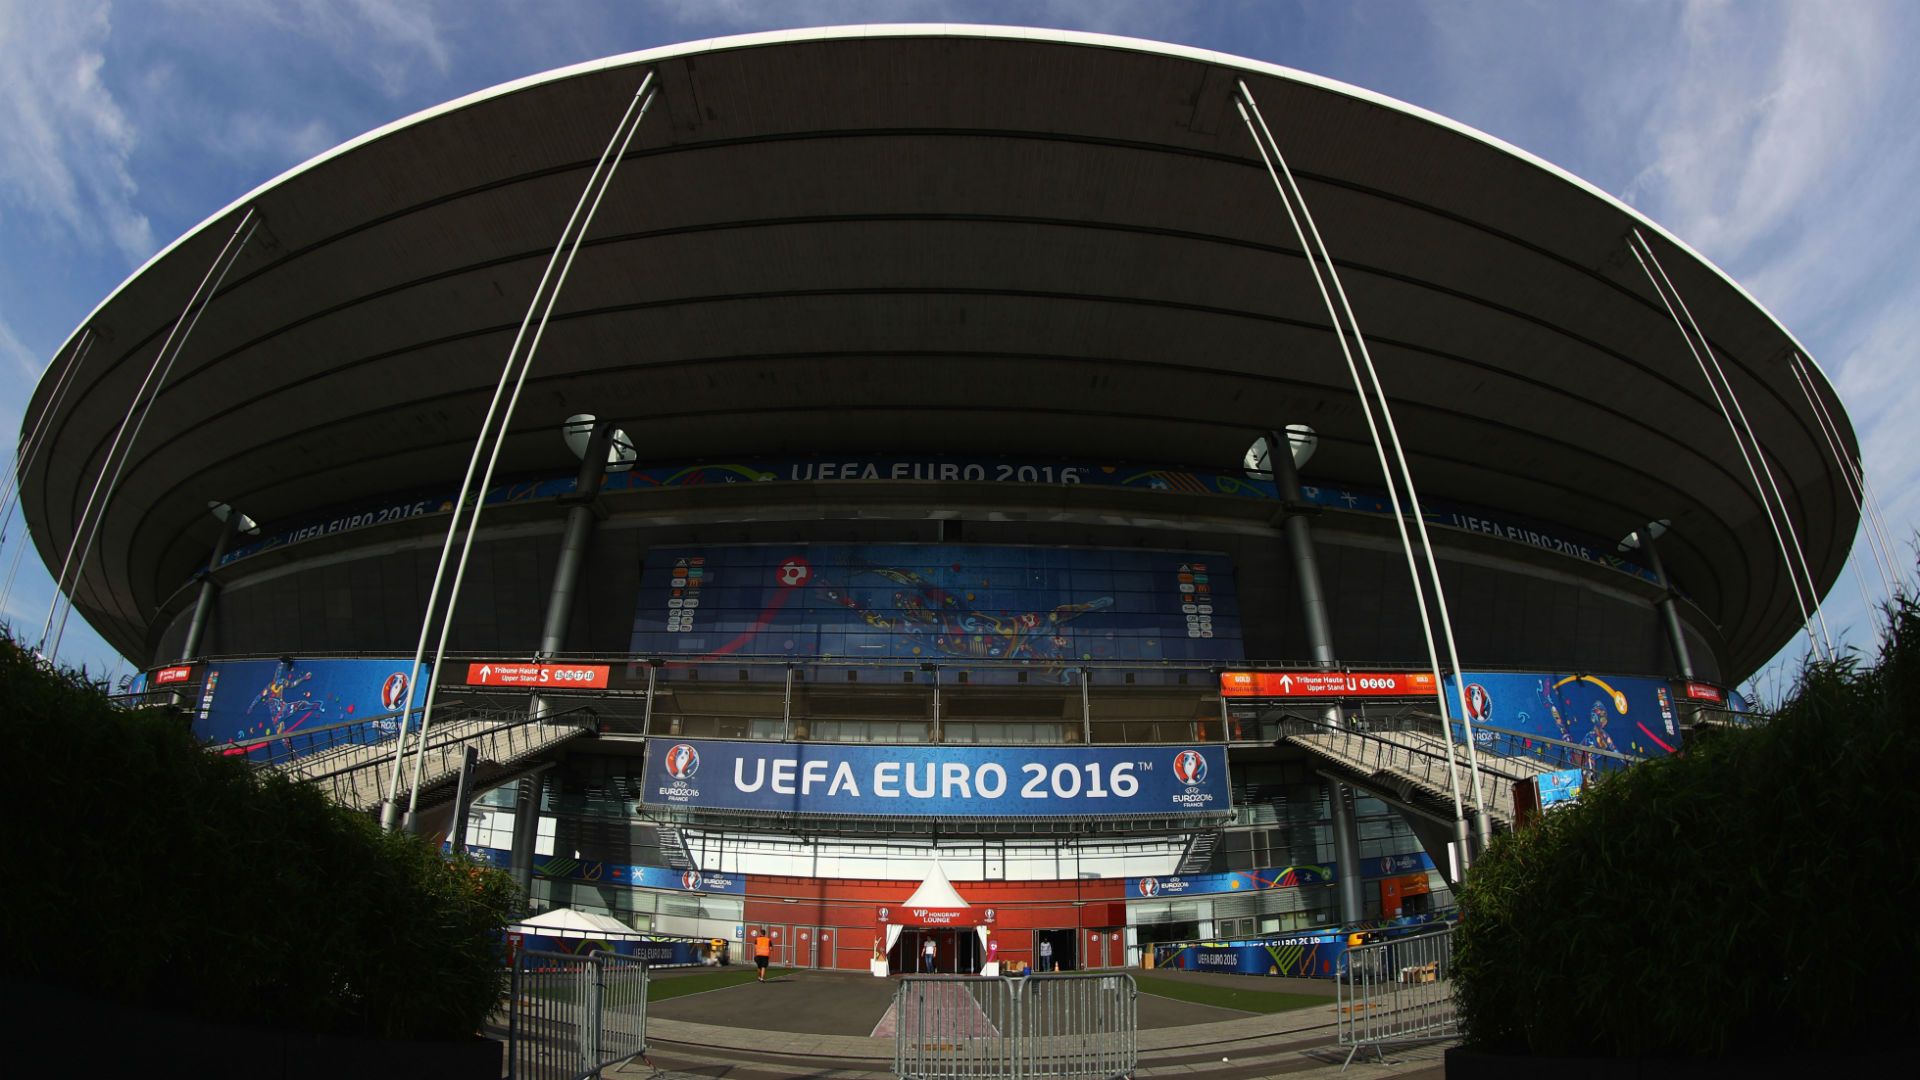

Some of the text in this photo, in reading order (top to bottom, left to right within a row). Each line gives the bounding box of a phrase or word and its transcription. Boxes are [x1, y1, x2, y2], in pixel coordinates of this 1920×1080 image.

[792, 463, 881, 481] UEFA
[891, 463, 987, 481] EURO
[996, 464, 1082, 487] 2016
[377, 501, 425, 522] 2016
[540, 669, 549, 683] S
[1296, 676, 1344, 684] Tribune Haute
[1306, 684, 1325, 692] Upper
[1346, 678, 1357, 691] U
[734, 757, 861, 797] UEFA
[873, 762, 1008, 799] EURO
[1020, 762, 1139, 799] 2016
[1198, 953, 1237, 966] UEFA EURO 2016
